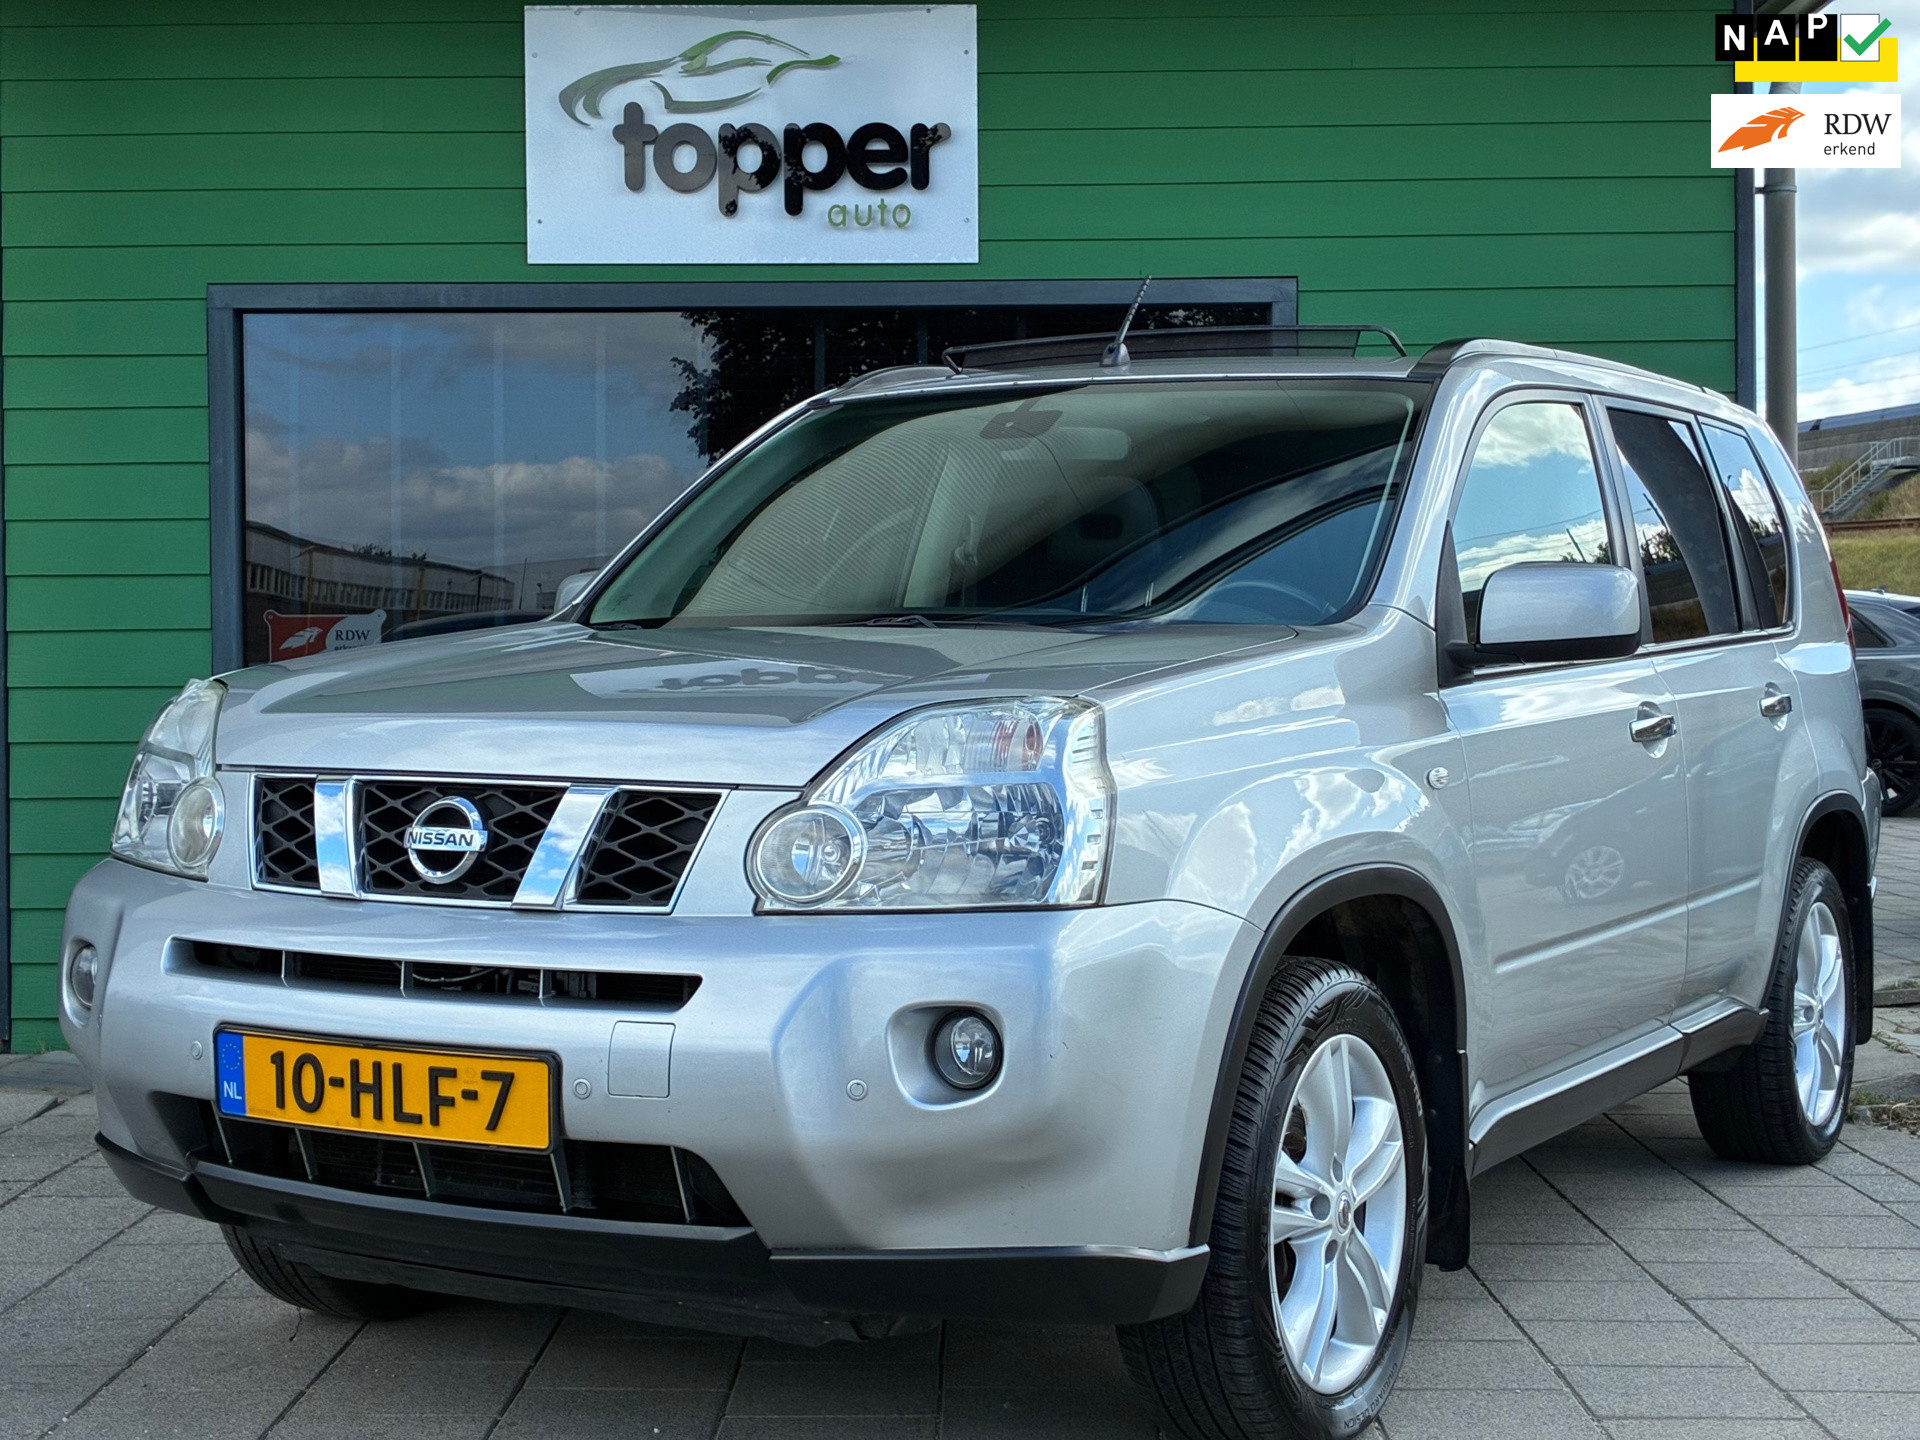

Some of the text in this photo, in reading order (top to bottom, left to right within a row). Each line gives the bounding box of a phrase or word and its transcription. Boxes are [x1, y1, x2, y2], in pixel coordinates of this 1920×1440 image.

[612, 102, 952, 217] topper
[827, 198, 912, 228] auto
[335, 629, 370, 641] RDW
[407, 831, 474, 847] NISSAN
[223, 1080, 242, 1101] NL
[270, 1050, 515, 1131] 10-HLF-7
